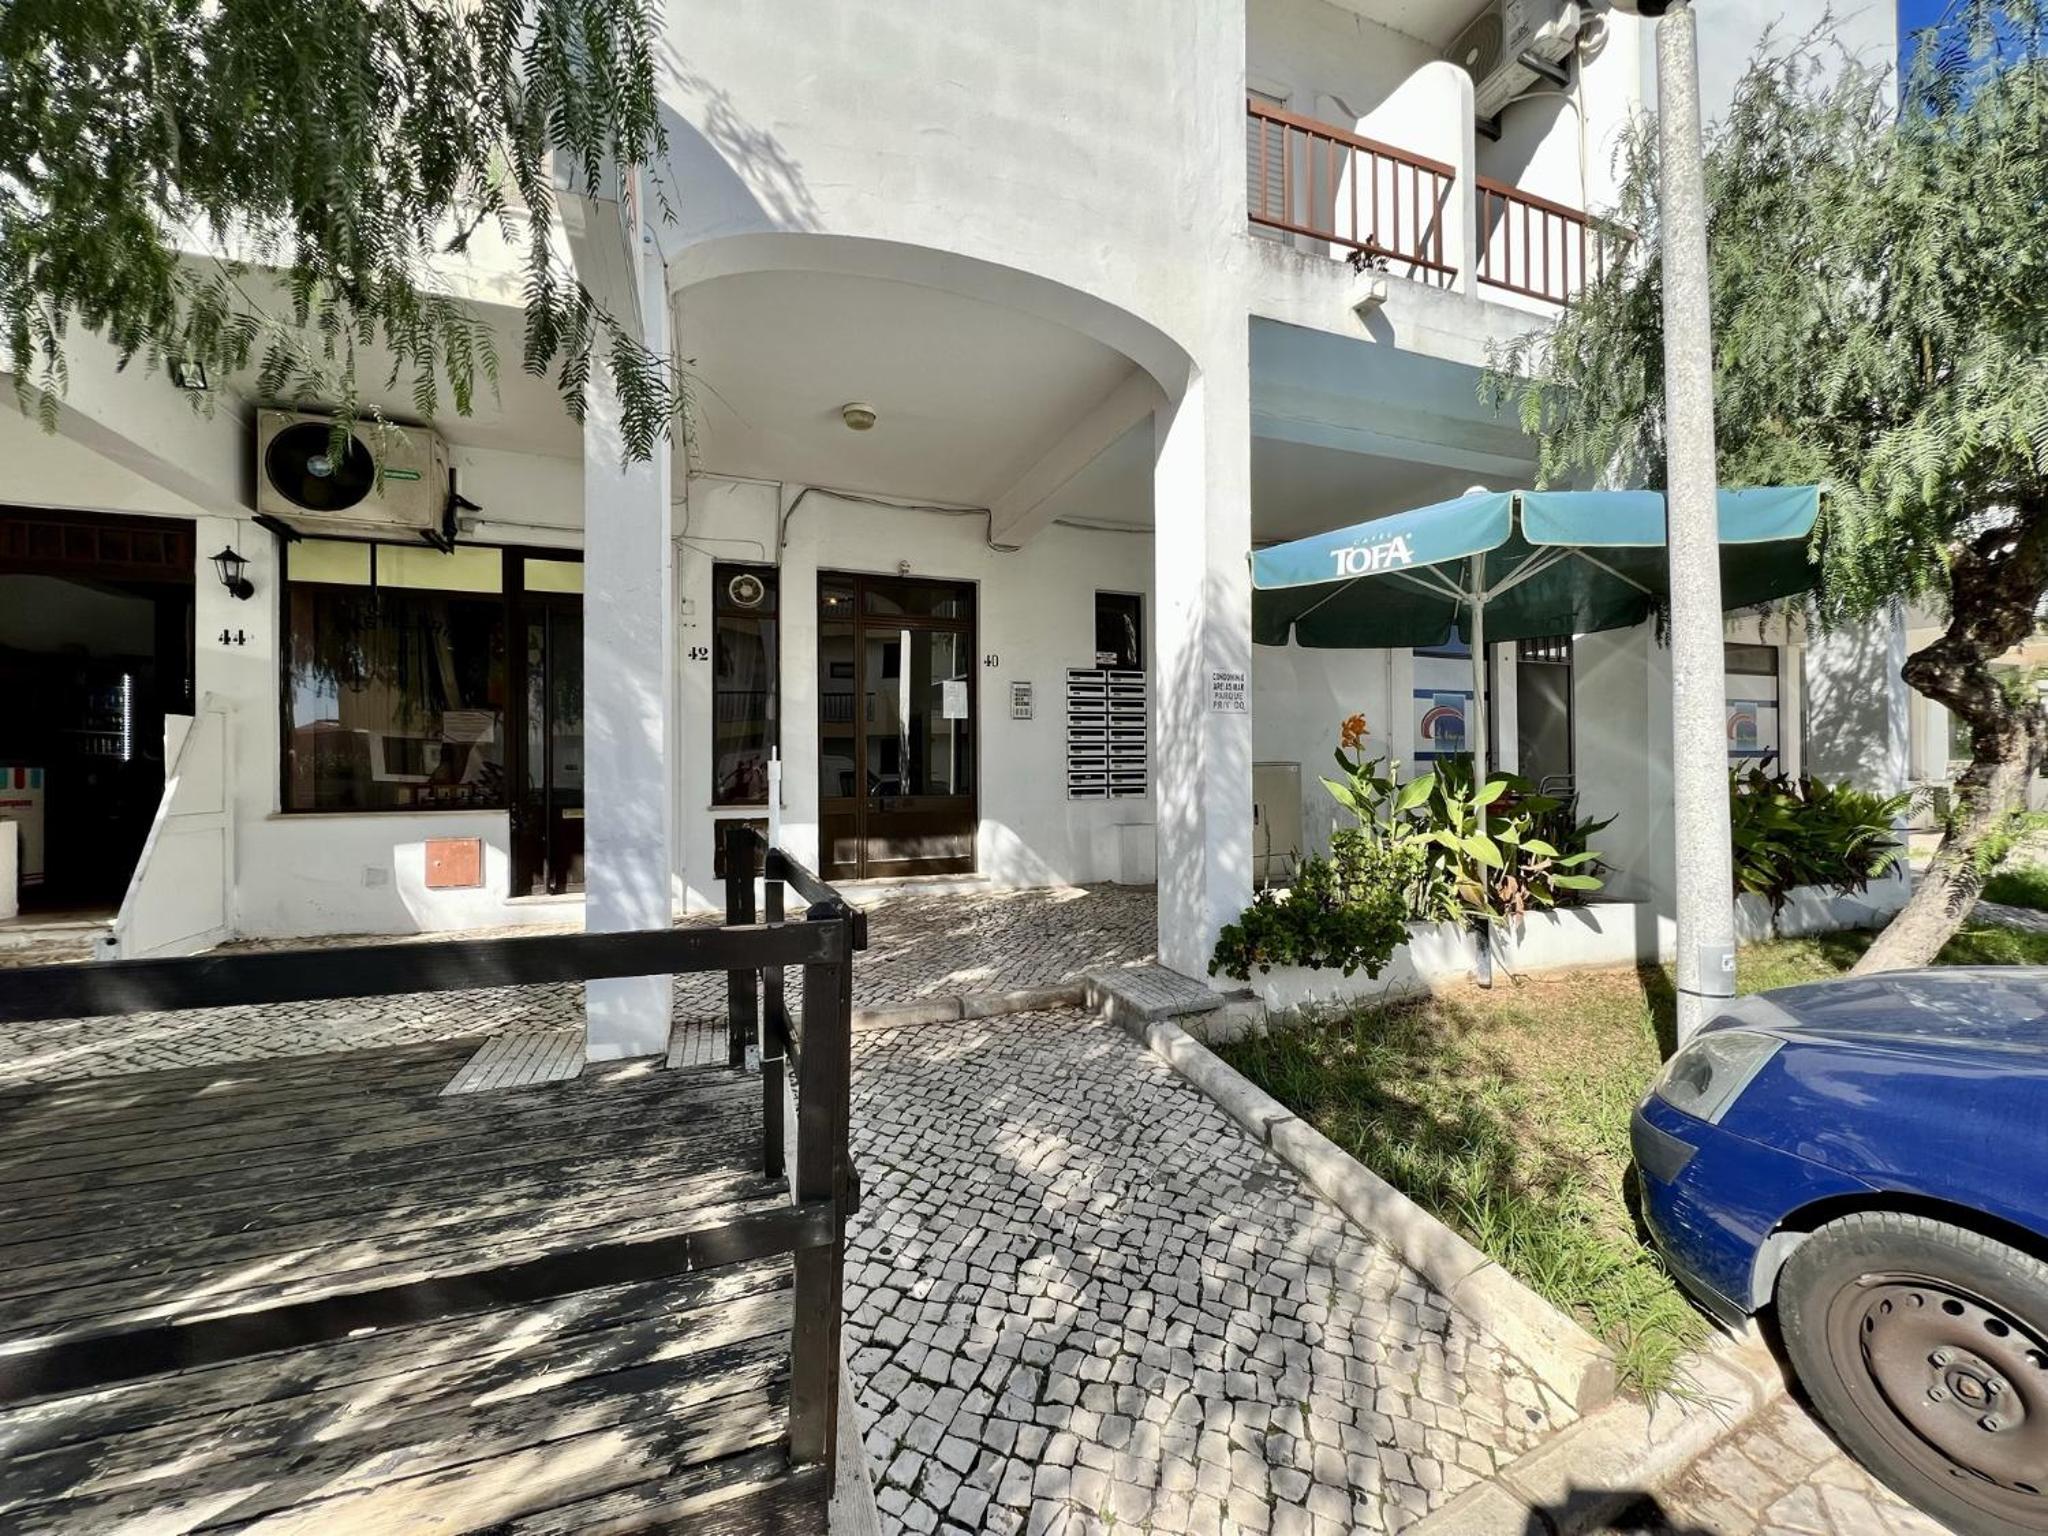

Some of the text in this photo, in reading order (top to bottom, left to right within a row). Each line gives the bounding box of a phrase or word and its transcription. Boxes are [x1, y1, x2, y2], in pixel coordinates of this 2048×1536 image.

[1330, 536, 1415, 576] TOFA
[218, 629, 246, 646] 44
[688, 646, 709, 661] 42
[984, 654, 999, 668] 40
[1214, 692, 1243, 700] PARQUE
[1213, 701, 1245, 710] PRIVDO
